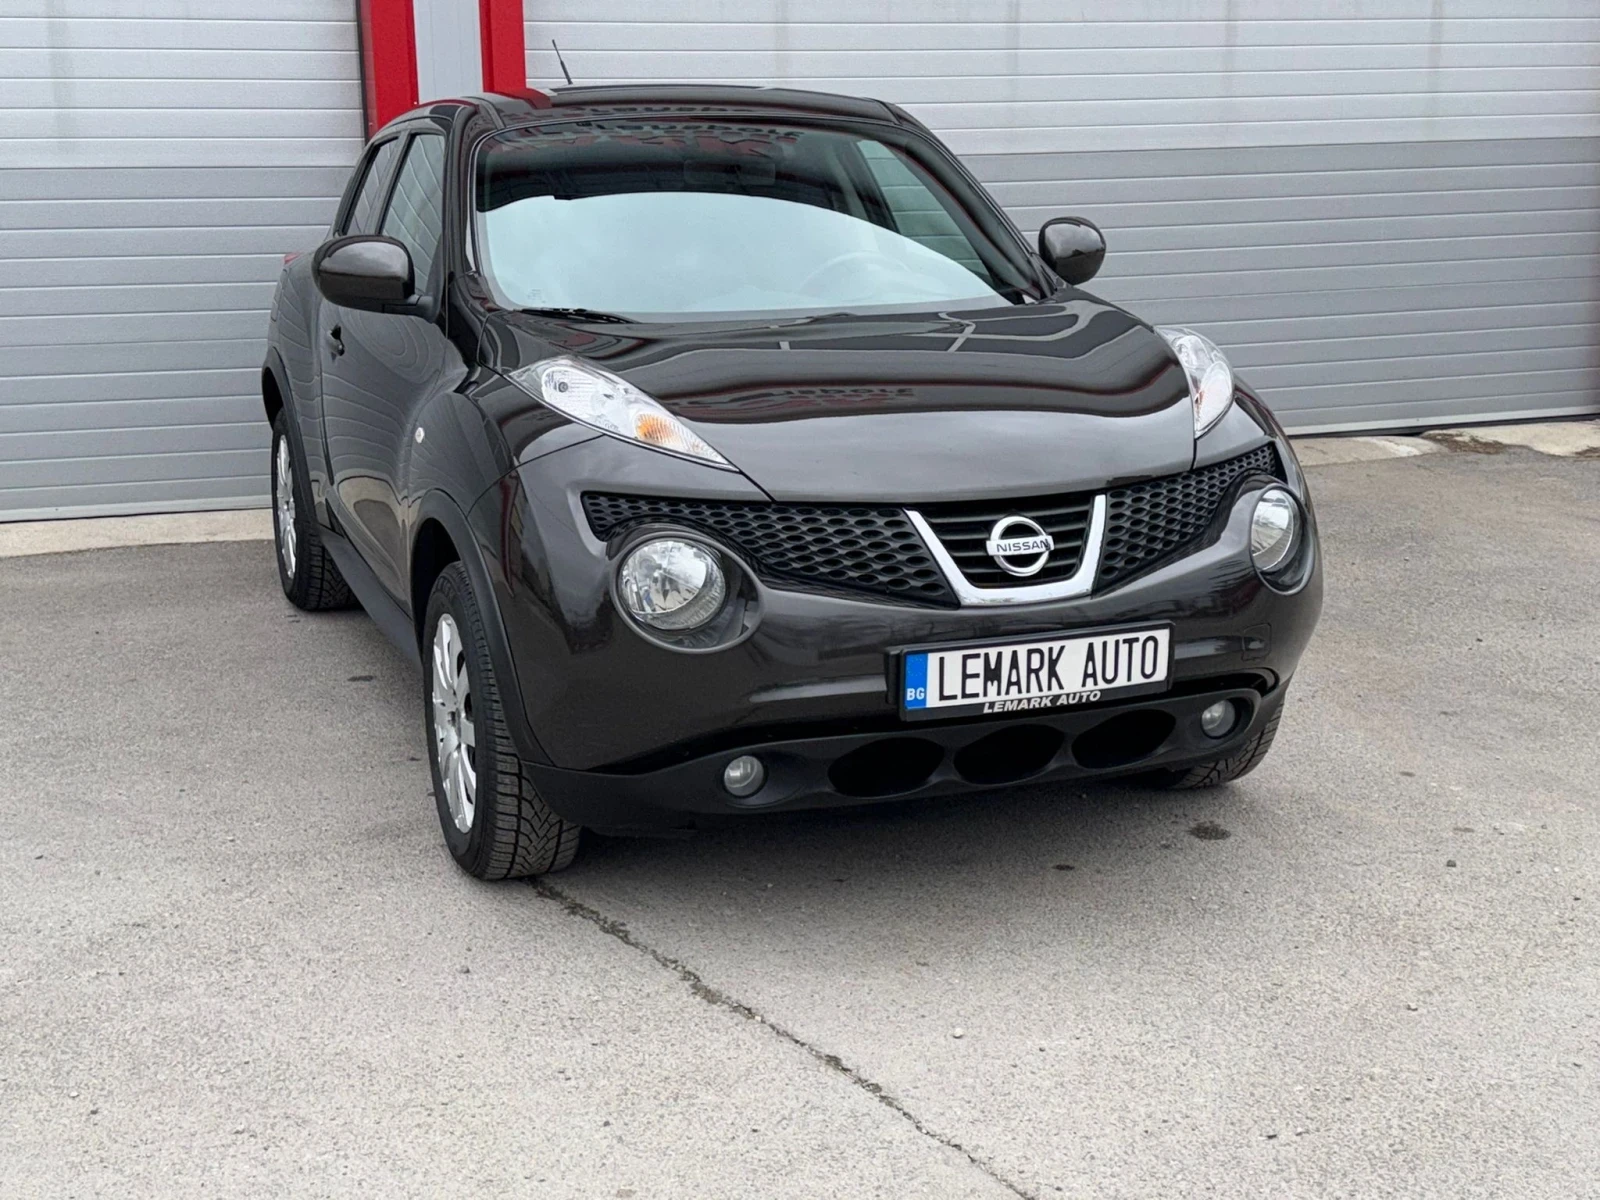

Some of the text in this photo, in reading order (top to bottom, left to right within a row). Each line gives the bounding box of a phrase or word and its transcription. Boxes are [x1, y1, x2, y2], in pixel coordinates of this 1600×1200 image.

[996, 538, 1050, 552] NISSAN
[939, 635, 1158, 701] LEMARK AUTO
[906, 687, 925, 701] BG
[983, 690, 1101, 714] LEMARK AUTO
